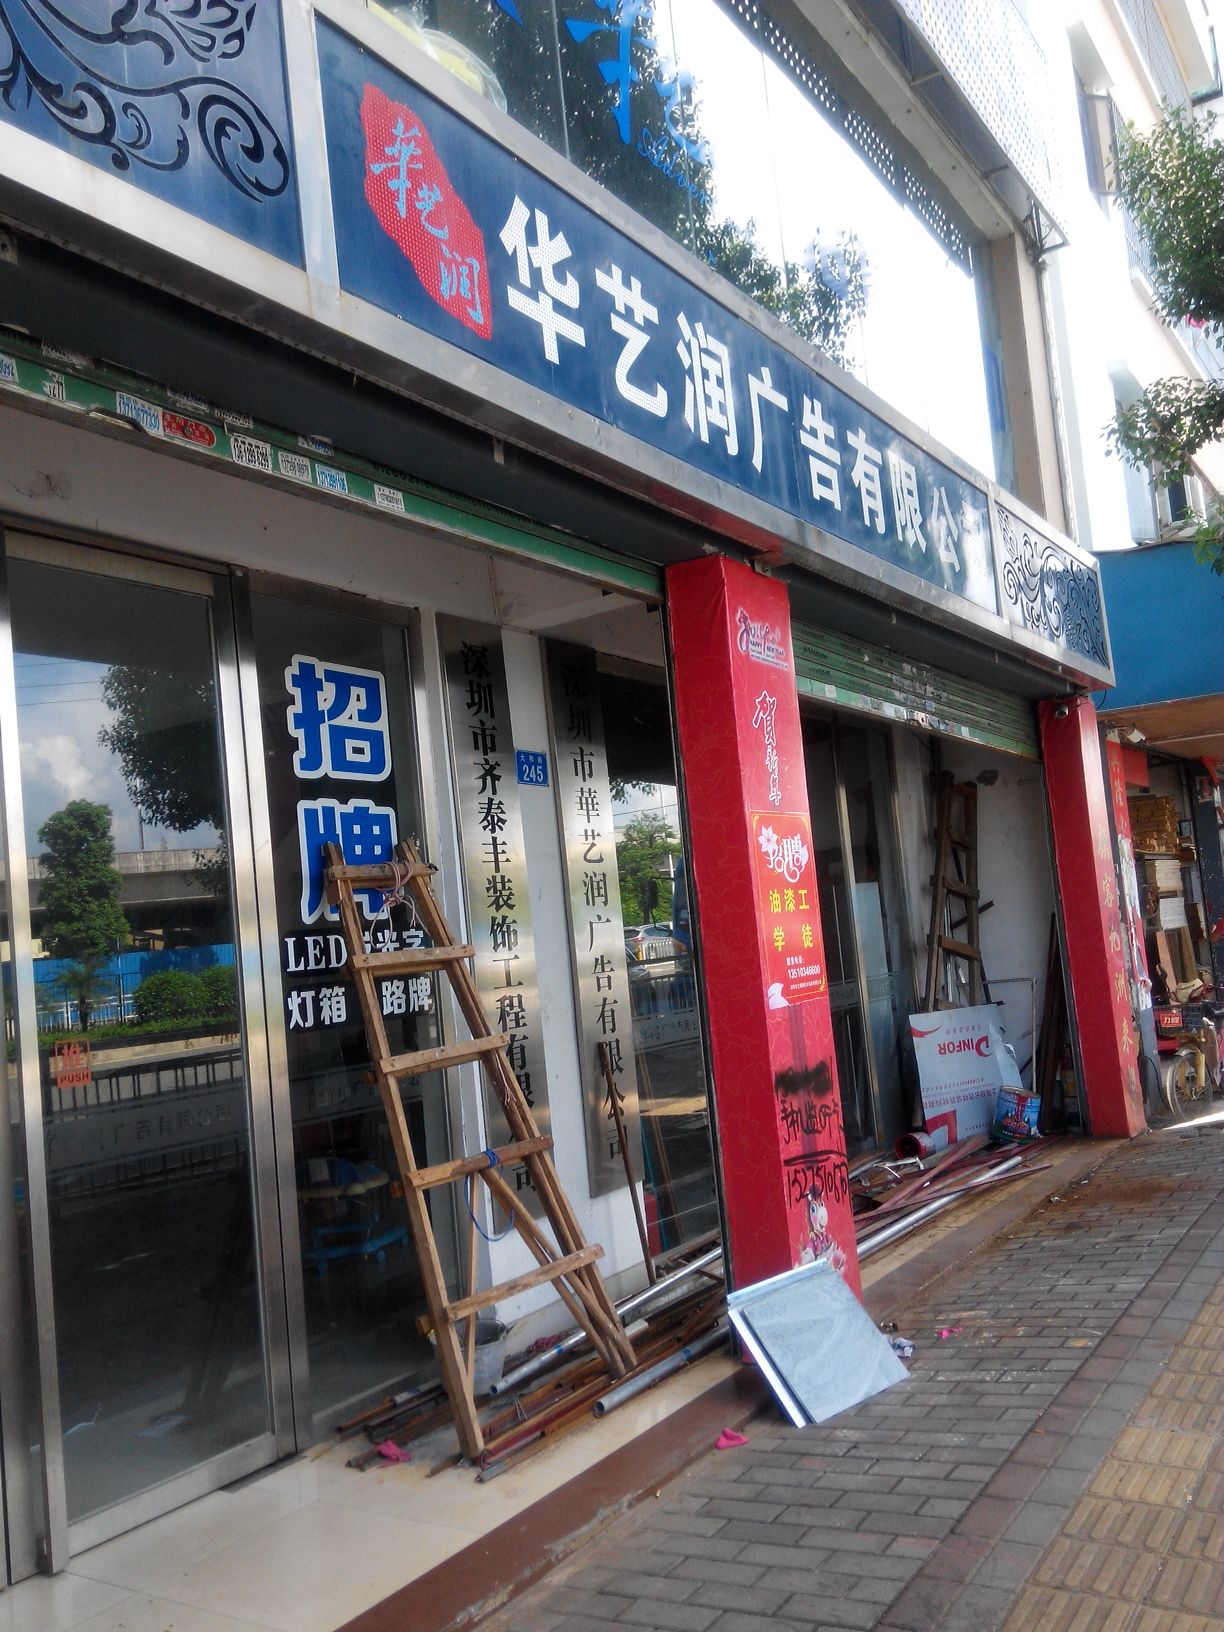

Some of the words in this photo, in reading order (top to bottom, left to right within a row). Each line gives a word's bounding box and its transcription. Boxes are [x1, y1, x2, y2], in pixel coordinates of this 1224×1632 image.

[522, 764, 544, 782] 245
[769, 888, 810, 913] 油漆工
[287, 985, 347, 1030] 灯箱
[381, 976, 433, 1016] 路牌
[60, 1072, 89, 1084] PUSH
